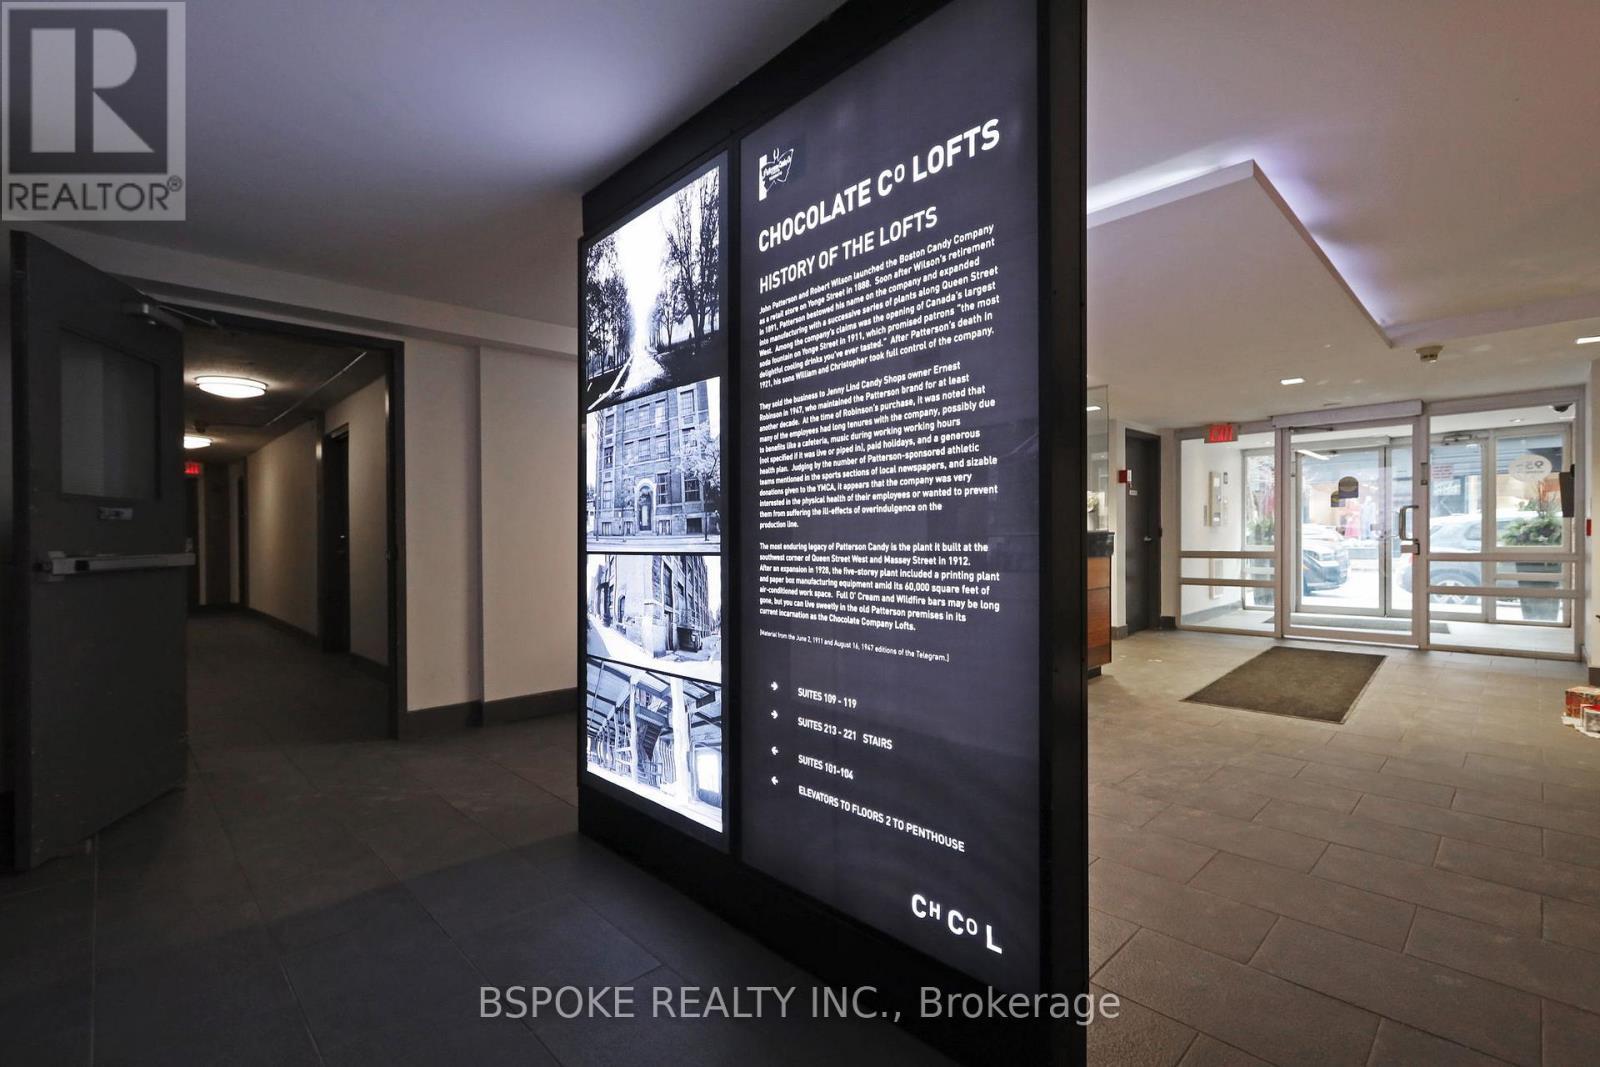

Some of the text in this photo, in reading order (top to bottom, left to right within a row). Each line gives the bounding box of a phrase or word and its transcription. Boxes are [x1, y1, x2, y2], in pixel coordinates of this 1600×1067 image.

[759, 179, 871, 252] CHOCOLATE
[913, 118, 1000, 182] LOFTS
[760, 206, 938, 294] HISTORY OF THE LOFTS
[853, 224, 994, 279] launched the Boston Candy Company
[894, 267, 911, 278] after
[948, 238, 994, 260] retirement
[888, 256, 979, 293] company and expanded
[885, 266, 998, 307] of plants along Queen Street
[886, 306, 914, 320] opening
[916, 301, 924, 310] of
[964, 281, 995, 297] largest
[887, 315, 922, 334] promised
[923, 308, 954, 324] patrons
[977, 295, 999, 308] most
[890, 334, 908, 344] After
[957, 314, 982, 327] death
[984, 312, 992, 321] in
[886, 348, 898, 358] full
[900, 341, 926, 354] control
[928, 338, 936, 348] of
[938, 337, 951, 346] the
[861, 361, 960, 388] Candy Shops owner Ernest
[901, 374, 969, 394] brand for at least
[917, 396, 922, 404] it
[924, 394, 940, 403] was
[942, 388, 966, 400] noted
[967, 385, 985, 395] that
[890, 413, 902, 421] the
[942, 401, 976, 416] possibly
[978, 399, 995, 408] due
[873, 419, 960, 436] working working hours
[917, 434, 932, 444] and
[940, 430, 980, 443] generous
[947, 443, 979, 454] athletic
[949, 458, 964, 468] and
[966, 456, 997, 466] sizable
[886, 478, 898, 486] the
[899, 477, 933, 486] company
[953, 474, 972, 483] very
[872, 491, 910, 501] employees
[922, 487, 952, 497] wanted
[953, 488, 962, 496] to
[964, 485, 998, 497] prevent
[861, 504, 916, 514] overindulgence
[929, 502, 942, 510] the
[835, 542, 988, 553] Patterson Candy is the plant it built at the
[883, 555, 910, 566] Massey
[912, 556, 936, 564] Street
[938, 556, 946, 565] in
[899, 569, 932, 578] included
[941, 570, 974, 582] printing
[976, 572, 1000, 582] plant
[893, 582, 902, 590] its
[931, 585, 959, 594] square
[961, 585, 978, 594] feet
[981, 586, 990, 595] of
[857, 592, 1000, 612] Cream and Wildfire bars may be long
[829, 614, 860, 624] Chocolate
[861, 617, 893, 630] Company
[871, 606, 966, 622] Patterson premises in its
[798, 687, 822, 701] SUITES
[824, 693, 836, 704] 109
[843, 697, 857, 708] 119
[798, 717, 823, 732] SUITES
[824, 724, 837, 735] 213
[843, 729, 857, 741] 221
[863, 733, 892, 749] STAIRS
[798, 754, 823, 770] SUITES
[799, 785, 965, 852] ELEVATORS TO FLOORS 2 TO PENTHOUSE
